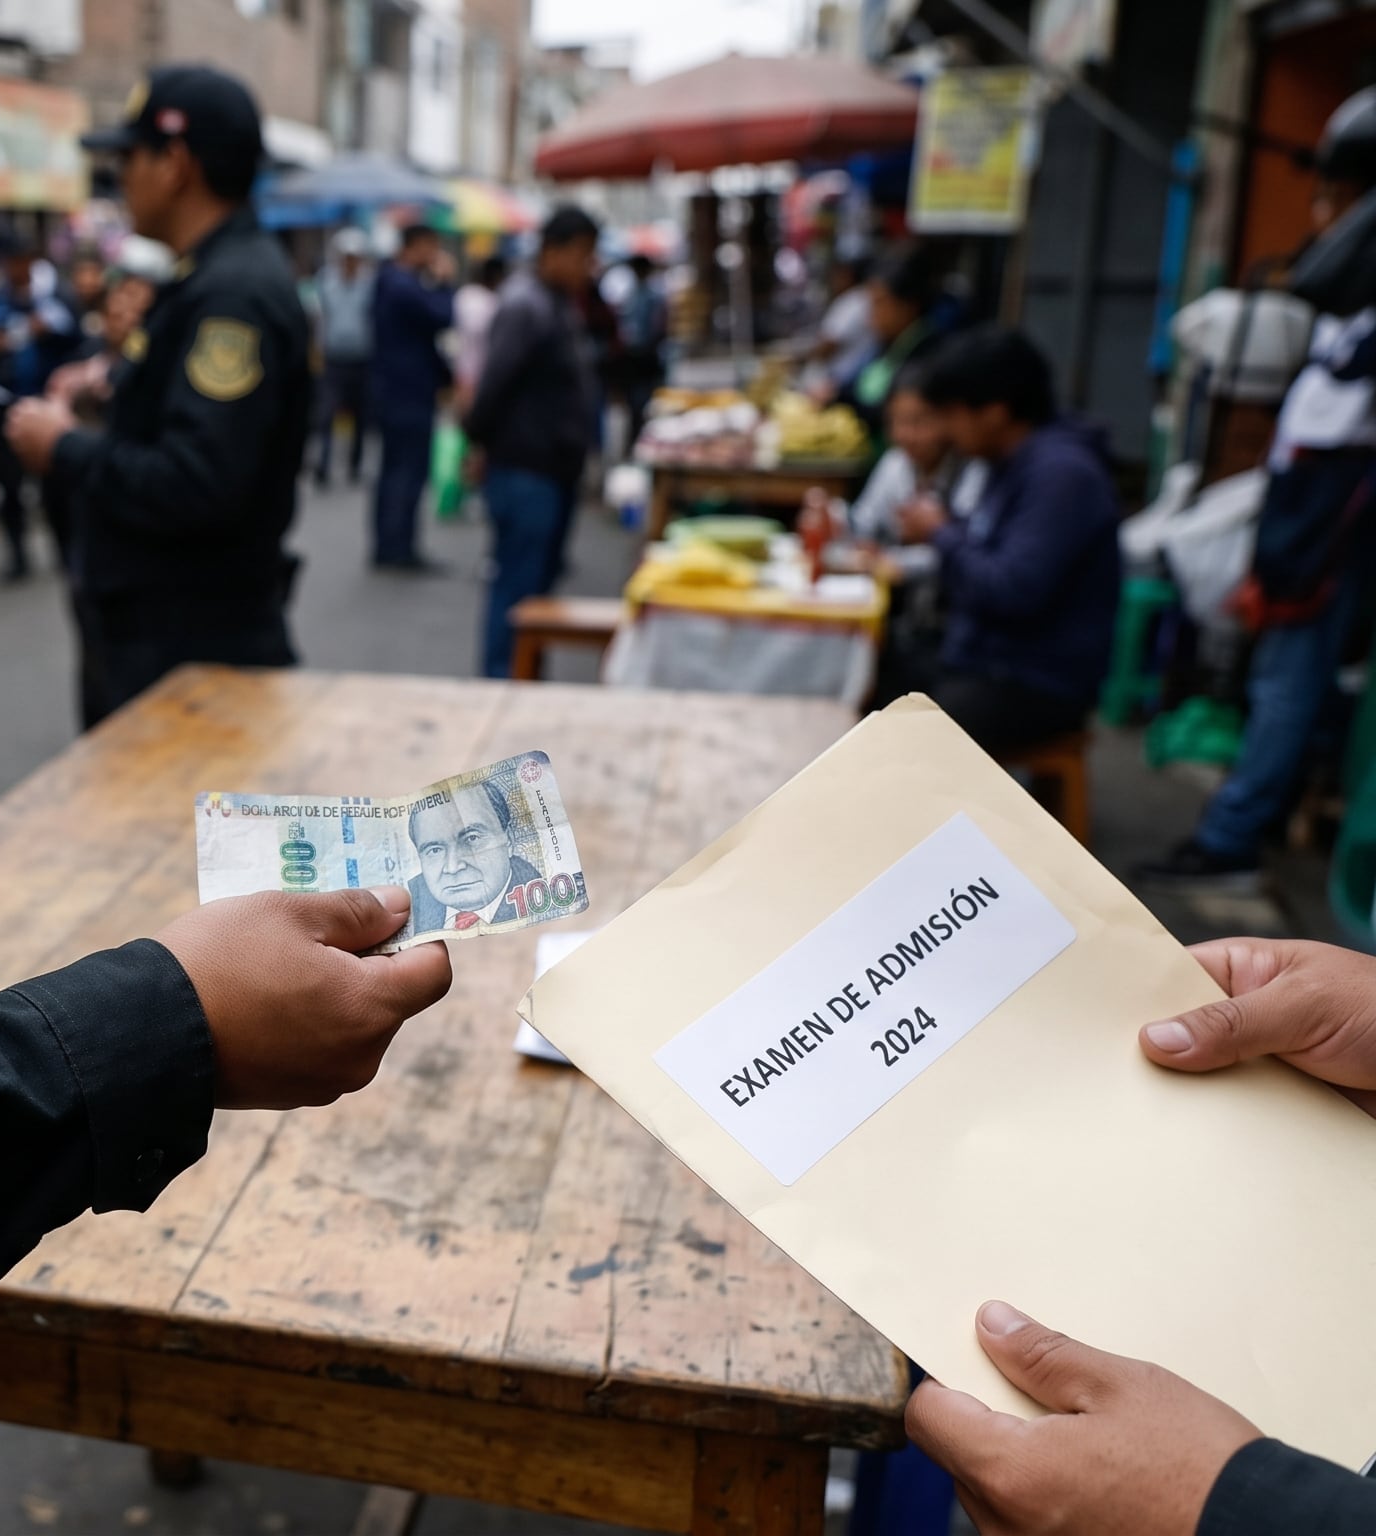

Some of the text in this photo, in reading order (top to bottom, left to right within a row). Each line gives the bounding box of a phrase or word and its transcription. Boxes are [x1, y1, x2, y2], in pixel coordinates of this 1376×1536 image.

[506, 872, 576, 919] 100
[720, 877, 1000, 1107] EXAMEN DE ADMISIÓN
[870, 1006, 938, 1067] 2024
